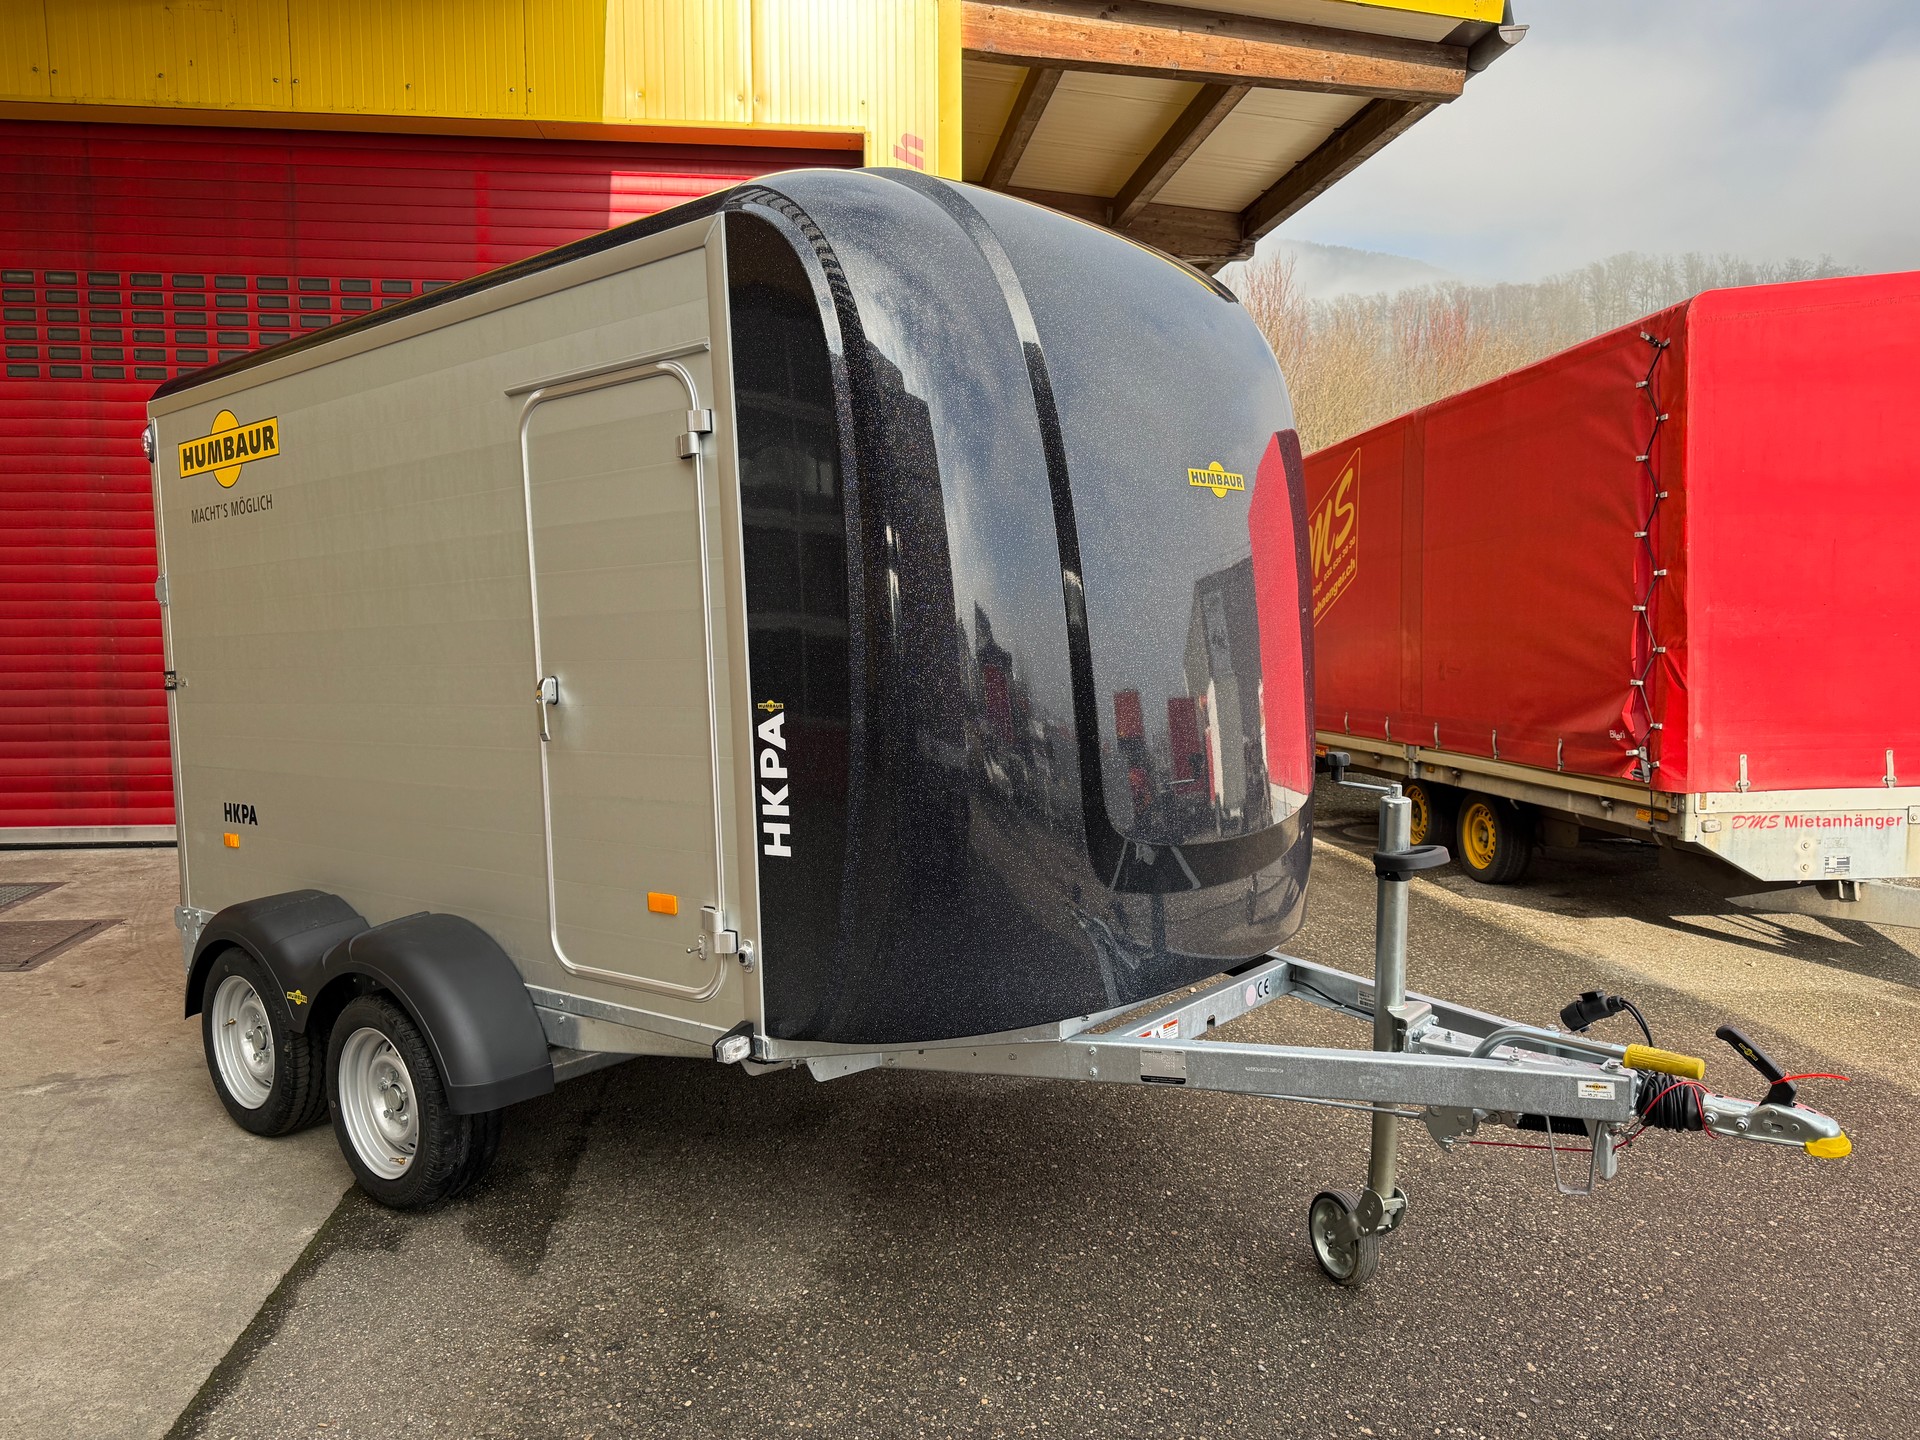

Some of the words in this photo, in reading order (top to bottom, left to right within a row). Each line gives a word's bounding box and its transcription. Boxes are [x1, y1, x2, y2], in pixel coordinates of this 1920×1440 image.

[182, 425, 276, 471] HUMBAUR
[1190, 471, 1243, 488] HUMBAUR
[191, 503, 228, 524] MACHT'S
[231, 494, 273, 517] MÖGLICH
[1309, 467, 1355, 578] MS
[1313, 558, 1356, 619] nhaenger.ch
[758, 711, 791, 857] HKPA
[223, 802, 258, 826] HKPA
[1732, 815, 1780, 829] DMS
[1784, 814, 1903, 830] Mietanhänger
